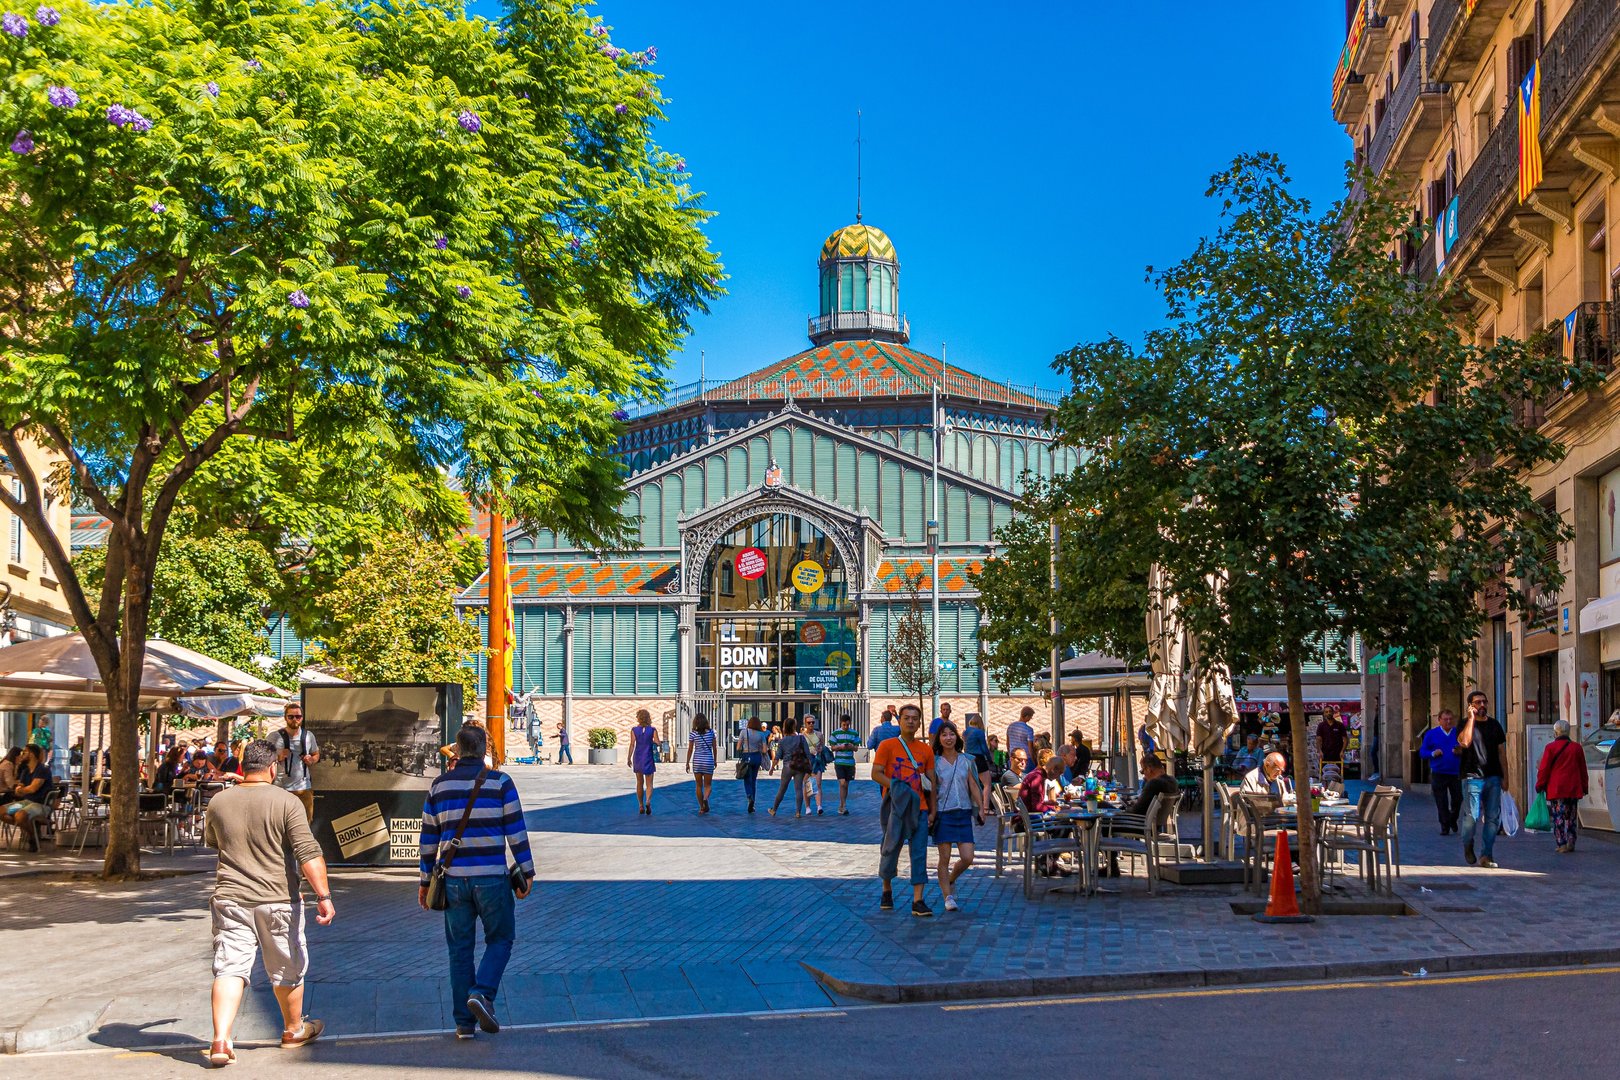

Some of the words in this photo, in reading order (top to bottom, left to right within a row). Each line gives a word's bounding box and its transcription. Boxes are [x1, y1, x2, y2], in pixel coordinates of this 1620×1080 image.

[721, 624, 741, 642] EL
[721, 647, 767, 666] BORN
[721, 670, 758, 690] CCM
[338, 826, 365, 844] BORN.
[392, 834, 412, 844] D'UN
